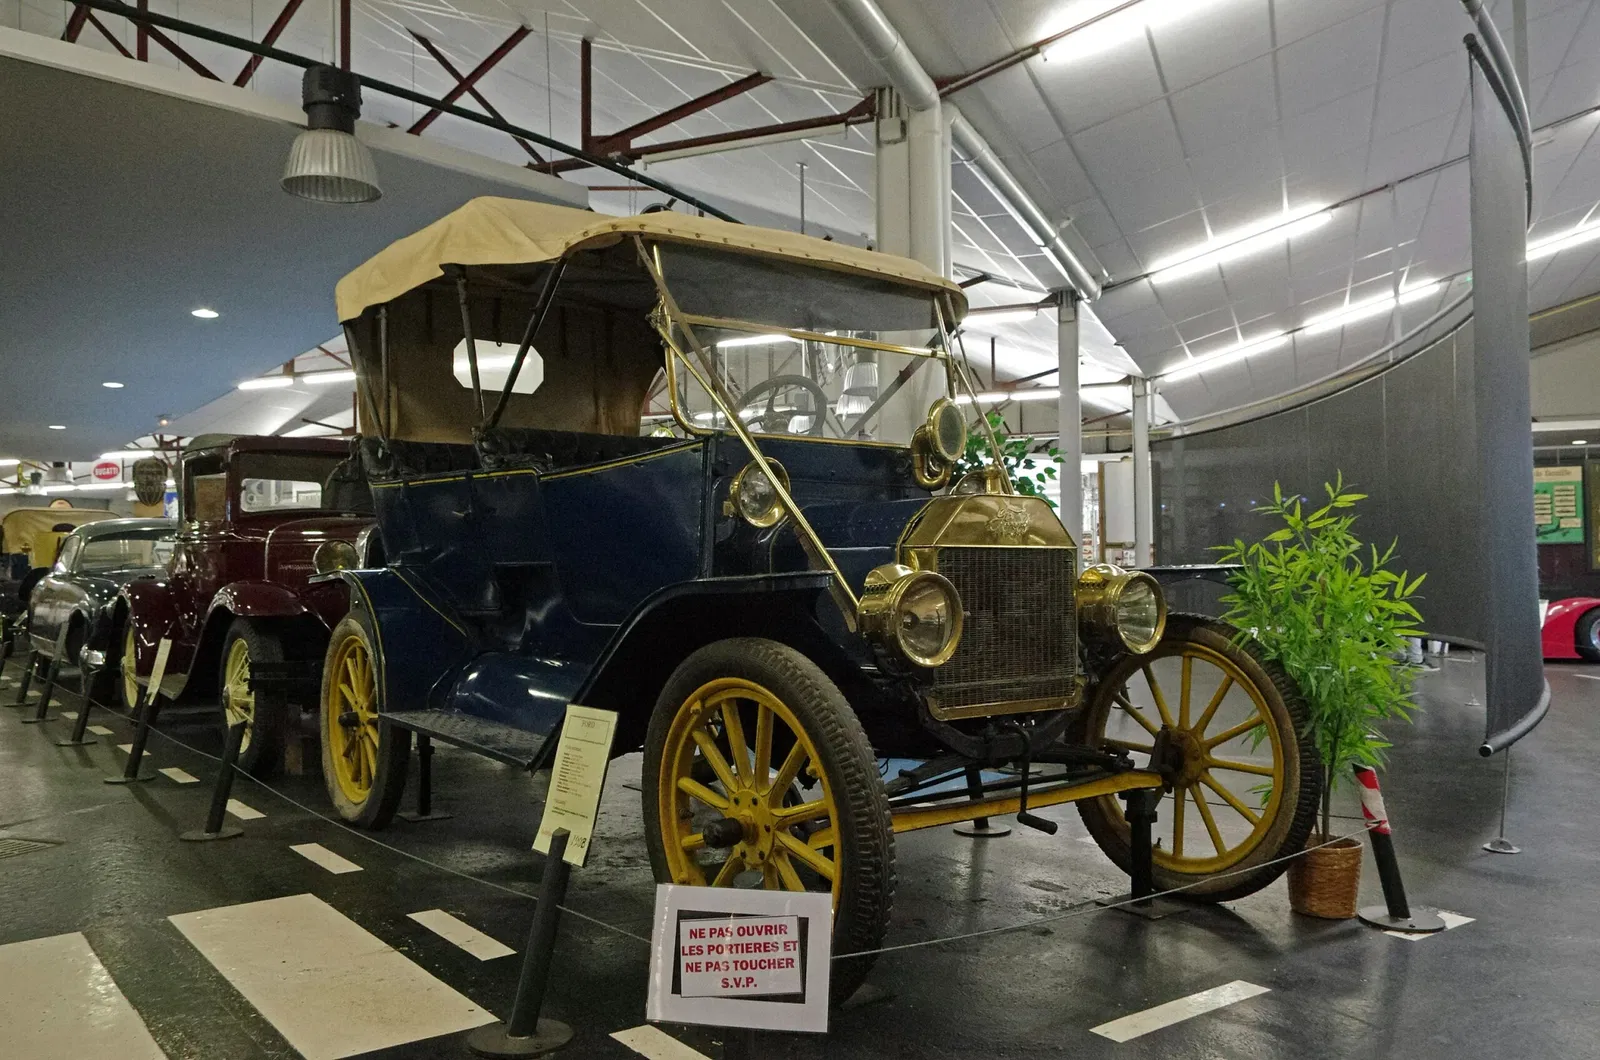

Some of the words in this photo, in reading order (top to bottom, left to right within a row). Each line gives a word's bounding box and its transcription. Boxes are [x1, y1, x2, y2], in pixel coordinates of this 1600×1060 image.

[95, 467, 118, 476] BUGATTI
[689, 928, 706, 939] NE
[709, 927, 733, 938] PAS
[737, 924, 788, 937] OUVRIR
[682, 945, 704, 956] LES
[707, 941, 779, 955] PORTIERES
[783, 940, 798, 952] ET
[685, 962, 702, 973] NE
[705, 961, 730, 972] PAS
[733, 958, 795, 971] TOUCHER
[721, 977, 758, 988] S.V.P.
